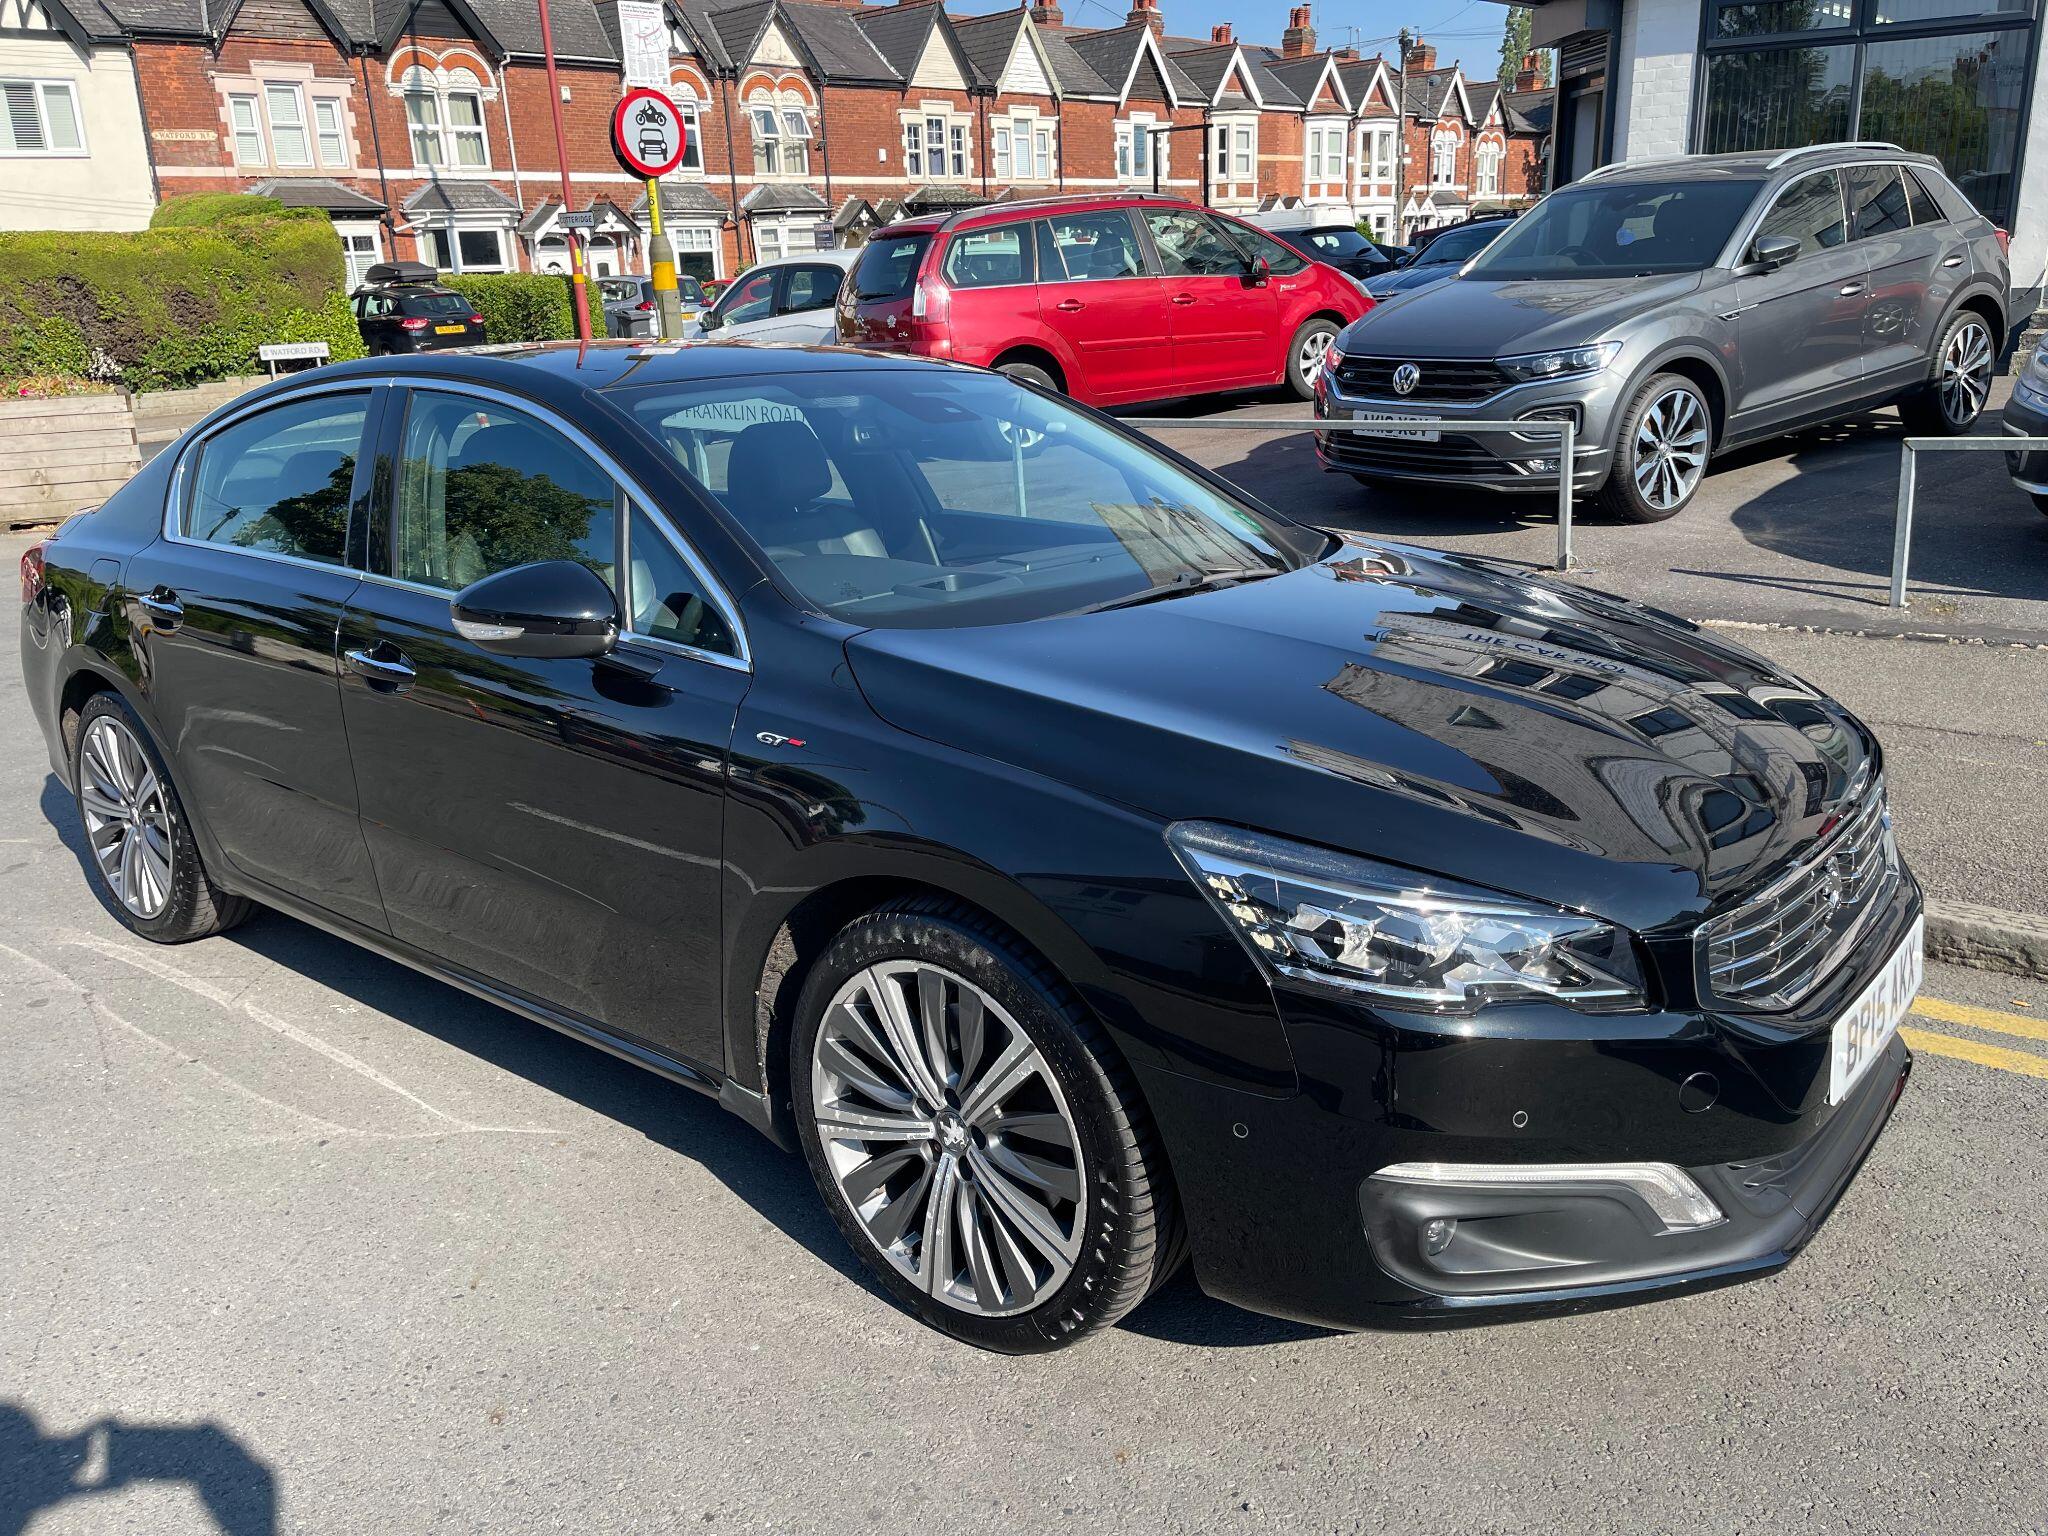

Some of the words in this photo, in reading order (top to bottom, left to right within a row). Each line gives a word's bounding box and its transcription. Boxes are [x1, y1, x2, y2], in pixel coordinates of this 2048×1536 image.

[158, 132, 197, 140] WATFORD
[270, 347, 306, 356] WATFORD
[685, 403, 757, 421] FRANKLIN
[1846, 974, 1887, 1078] BP15
[1890, 935, 1916, 1022] AKX
